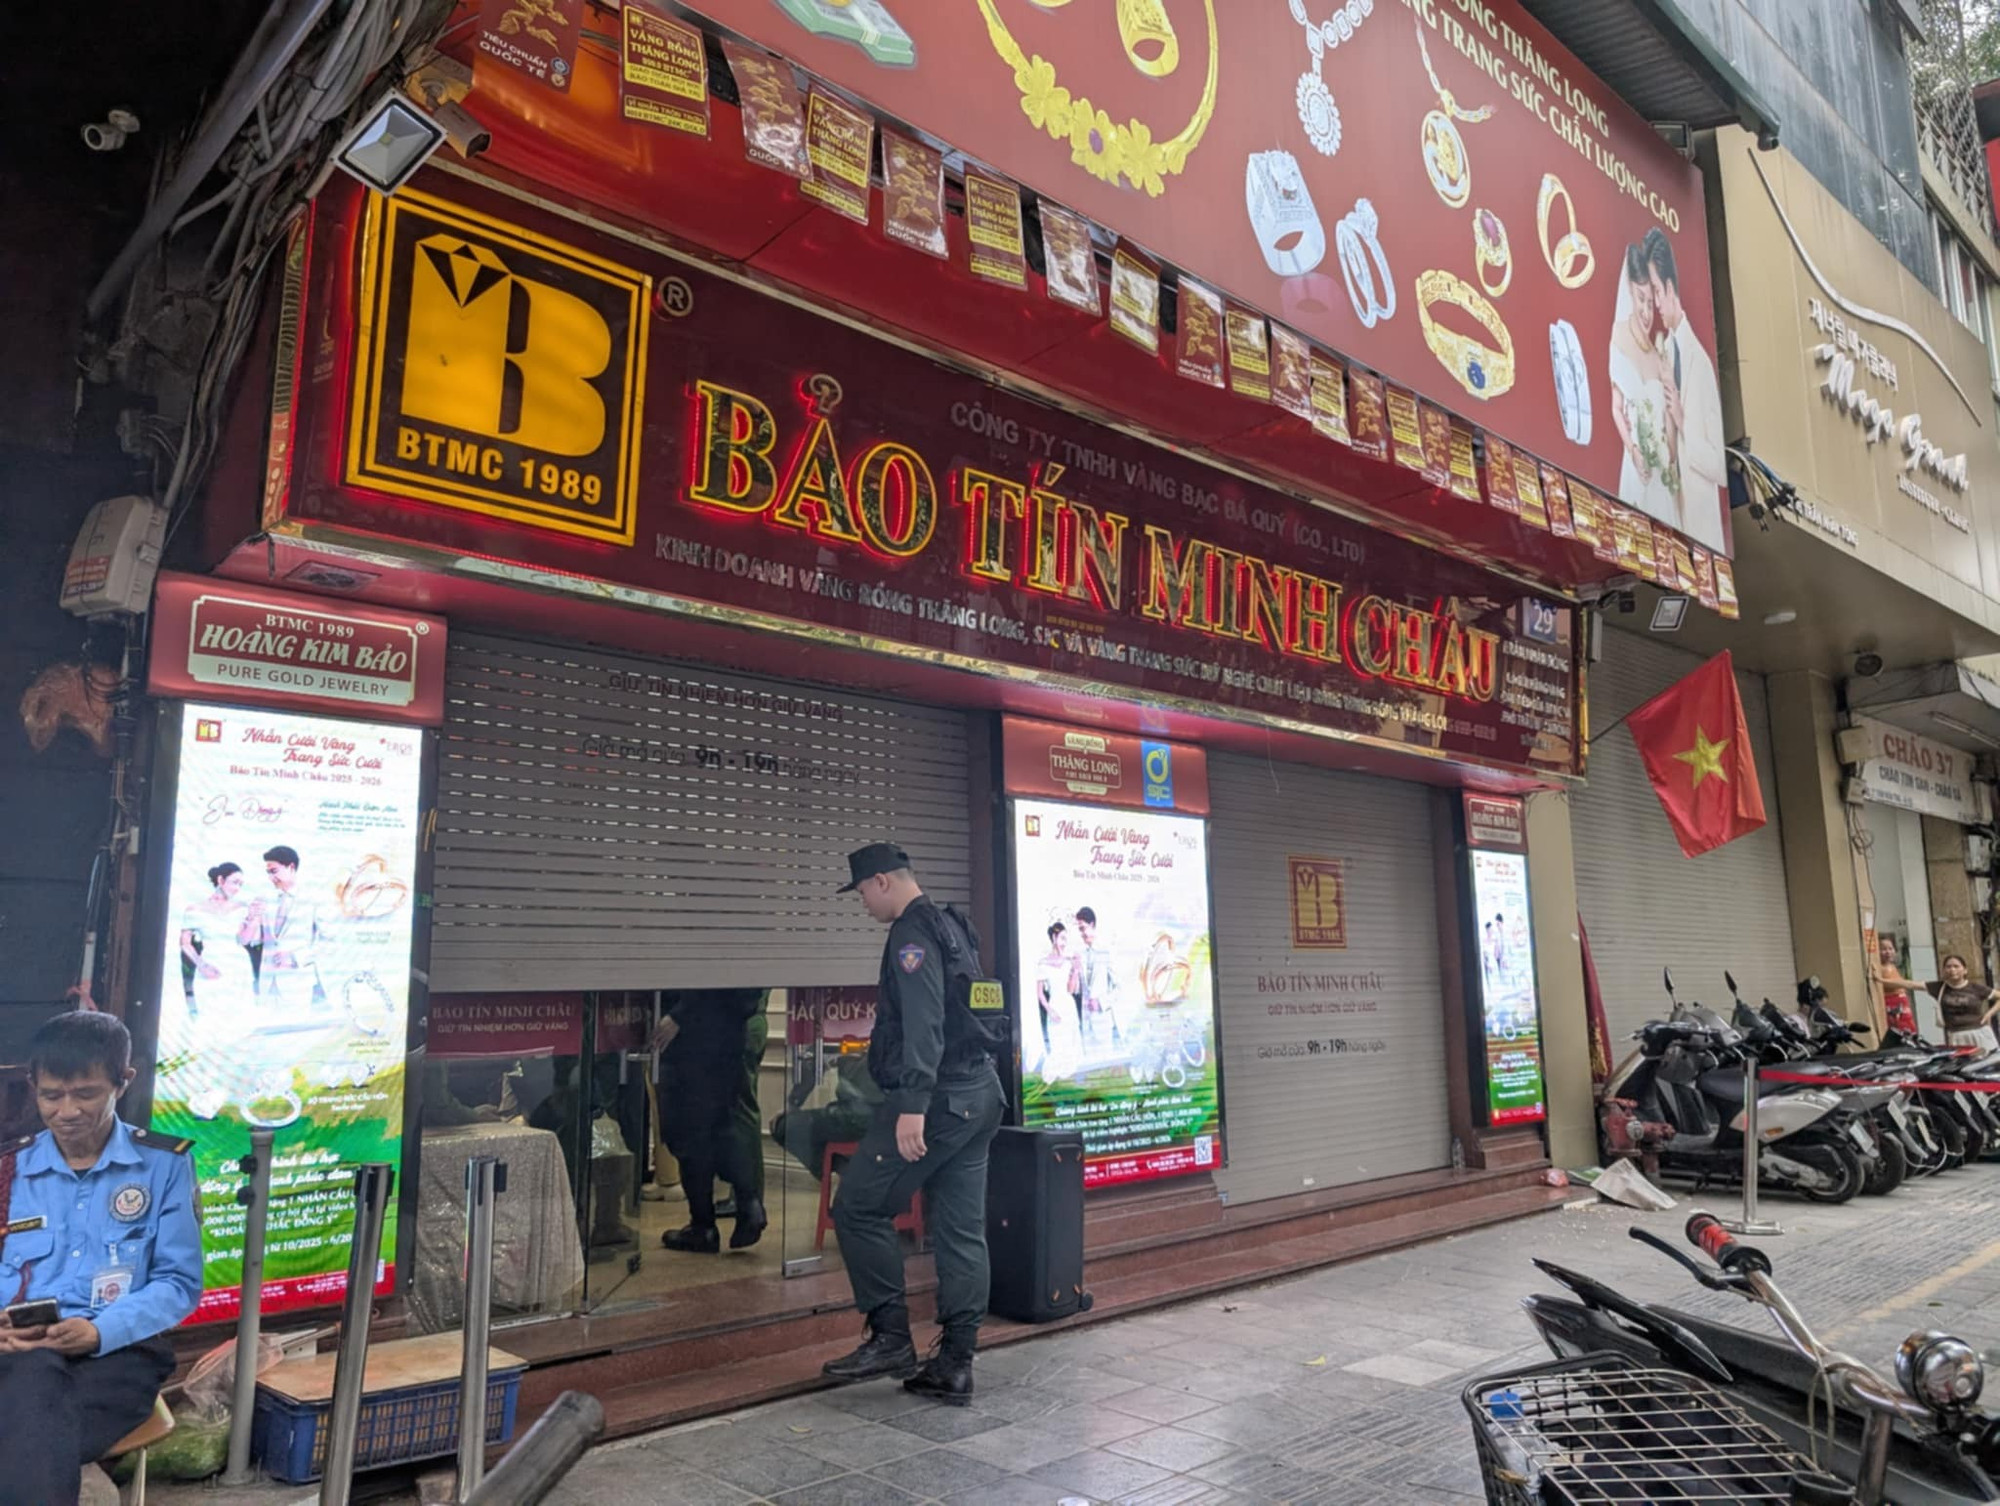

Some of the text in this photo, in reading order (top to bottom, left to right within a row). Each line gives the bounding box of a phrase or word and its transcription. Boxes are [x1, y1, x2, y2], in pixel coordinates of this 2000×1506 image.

[630, 28, 664, 48] VÀNG
[479, 40, 523, 67] QUỐC
[671, 53, 701, 73] LONG
[1500, 21, 1609, 138] THĂNG LONG
[1440, 9, 1680, 233] TRANG SỨC CHẤT LƯỢNG CAO
[951, 401, 1019, 444] CÔNG
[1023, 427, 1055, 457] TY
[1061, 439, 1118, 480] TNHH
[1122, 460, 1176, 499] VÀNG
[397, 426, 602, 506] BTMC 1989
[689, 373, 1500, 702] BẢO TÍN MINH CHÂU
[655, 533, 711, 570] KINH
[713, 547, 795, 589] DOANH
[799, 565, 853, 601] VÀNG
[917, 597, 977, 630] THĂNG
[266, 613, 355, 639] BTMC 1989
[1533, 603, 1554, 635] 29
[199, 624, 407, 673] HOÀNG KIM BẢO
[217, 663, 390, 697] PURE GOLD JEWELRY
[320, 736, 357, 753] Vàng
[282, 748, 324, 769] Trang
[694, 744, 721, 766] 9h
[743, 750, 779, 773] 19h
[1051, 753, 1119, 776] THĂNG LONG
[1935, 751, 1954, 778] 37
[1120, 828, 1150, 850] Vàng
[1090, 845, 1124, 870] Trang
[1258, 969, 1383, 993] BẢO TÍN MINH CHÂU
[468, 1003, 491, 1018] TÍN
[496, 1004, 533, 1018] MINH
[1307, 1039, 1321, 1055] 9h
[1329, 1038, 1348, 1054] 19h
